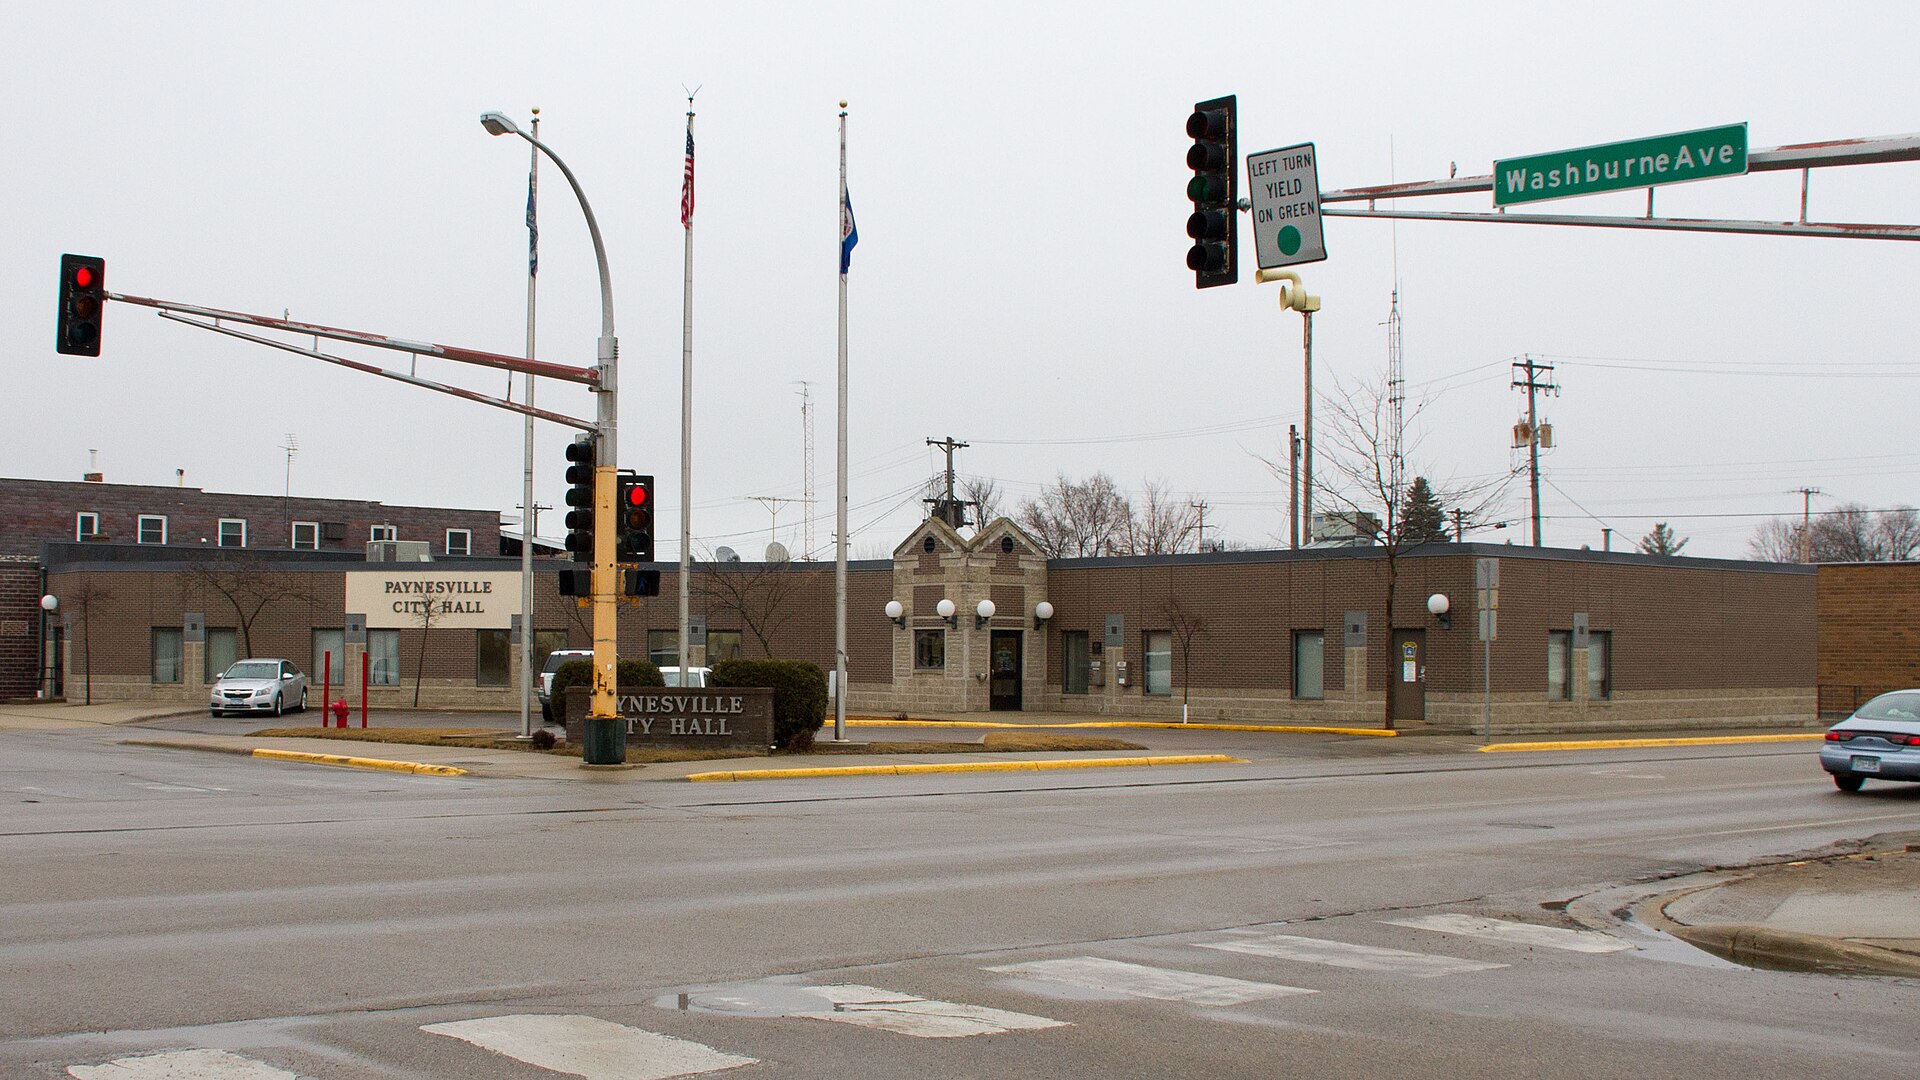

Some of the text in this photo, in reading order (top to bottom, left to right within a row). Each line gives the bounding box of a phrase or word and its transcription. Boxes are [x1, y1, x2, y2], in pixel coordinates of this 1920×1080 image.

[1252, 154, 1312, 177] LEFT TURN
[1506, 143, 1735, 194] Washburne Ave
[1266, 178, 1302, 199] YIELD
[1258, 201, 1315, 223] ON GREEN
[385, 581, 493, 594] PAYNESVILLE
[392, 601, 485, 613] CITY HALL
[589, 695, 743, 714] YNESVILLE
[625, 717, 733, 736] TY HALL
